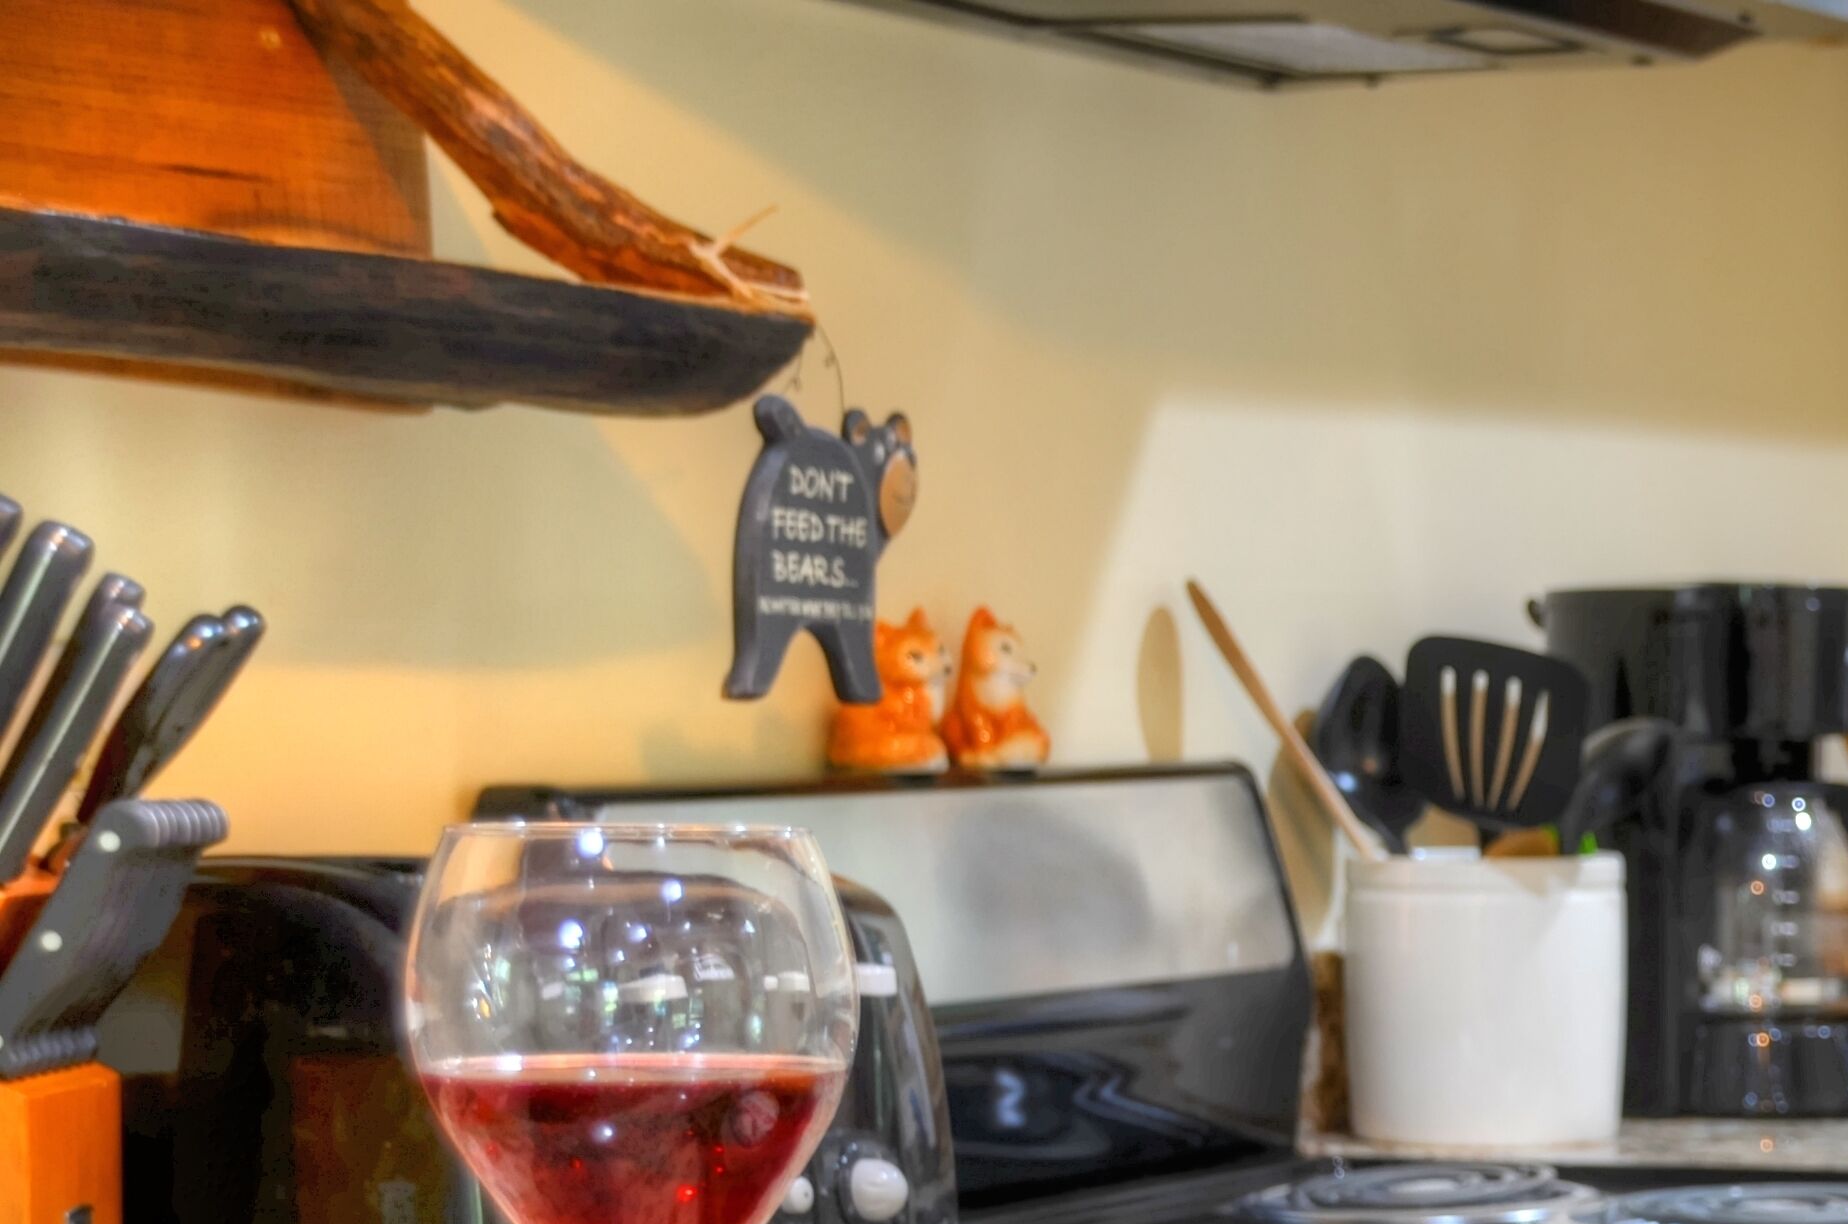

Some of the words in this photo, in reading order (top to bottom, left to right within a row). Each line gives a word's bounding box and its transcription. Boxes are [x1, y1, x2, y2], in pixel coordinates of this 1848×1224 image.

[790, 466, 853, 501] DON'T
[772, 508, 824, 542] FEED
[827, 515, 868, 548] THE
